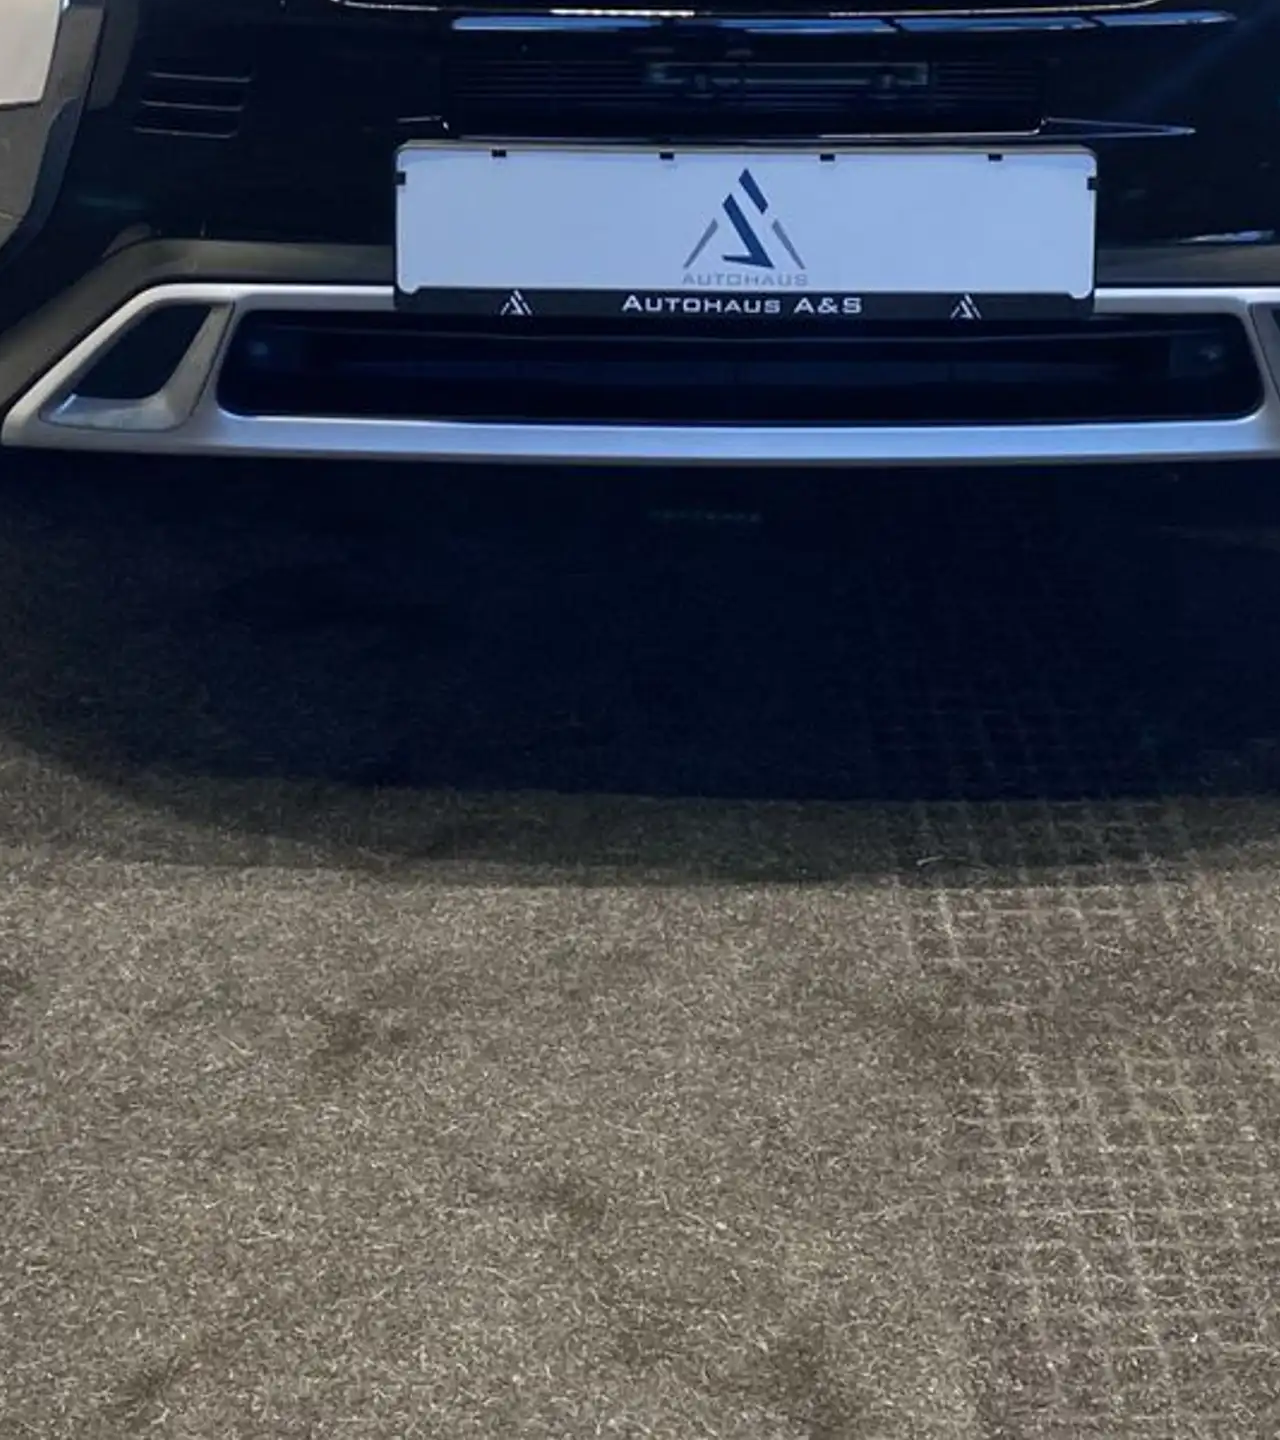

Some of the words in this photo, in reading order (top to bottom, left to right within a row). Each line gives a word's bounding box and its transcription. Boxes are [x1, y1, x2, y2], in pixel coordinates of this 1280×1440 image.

[682, 273, 808, 287] AUTOHAUS
[622, 295, 781, 313] AUTOHAUS
[793, 297, 862, 313] A&S
